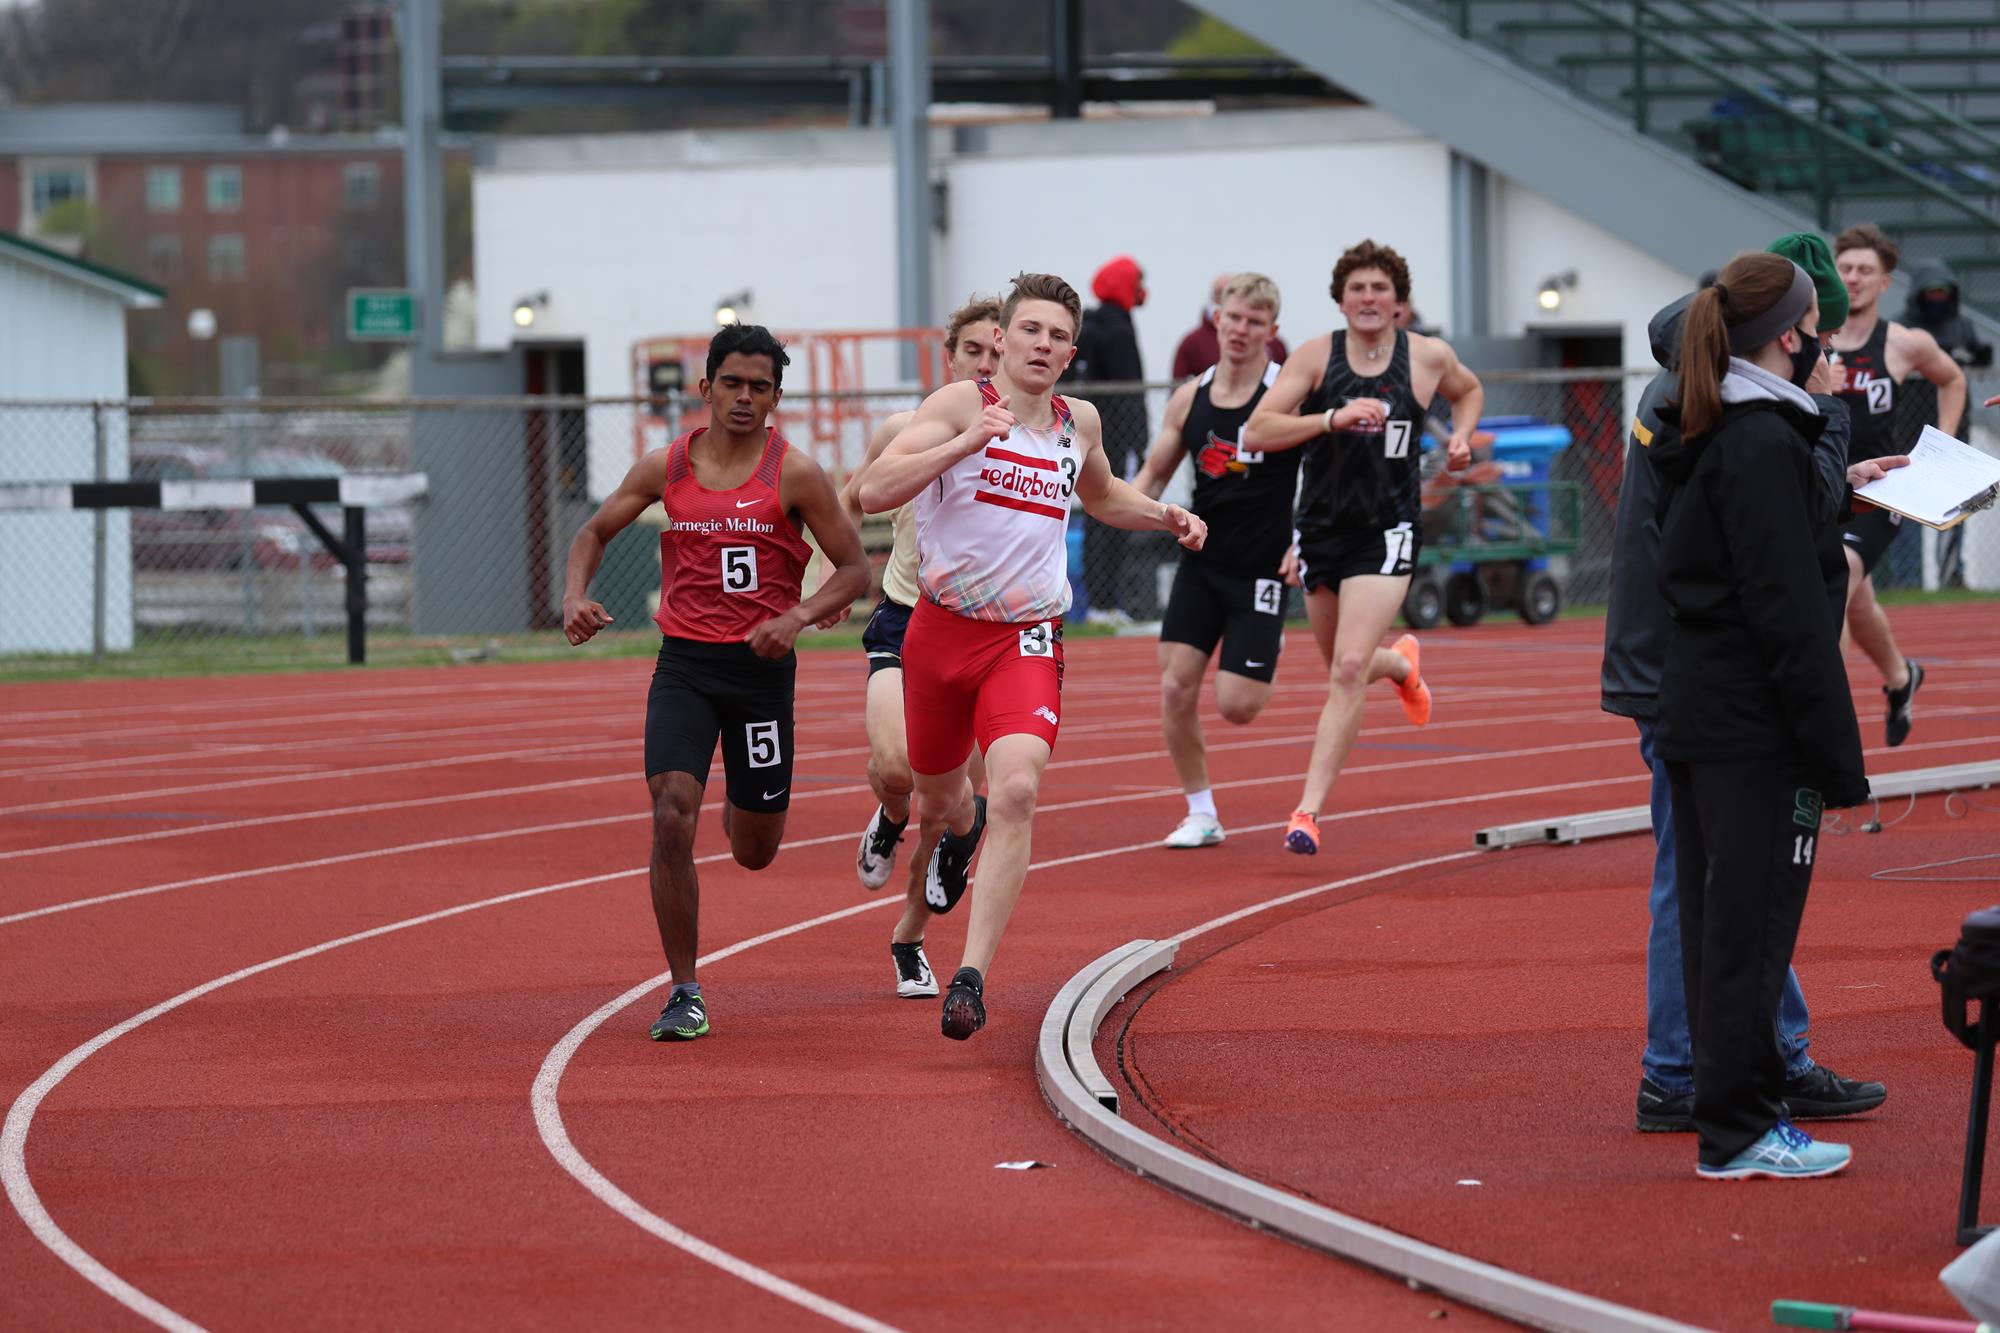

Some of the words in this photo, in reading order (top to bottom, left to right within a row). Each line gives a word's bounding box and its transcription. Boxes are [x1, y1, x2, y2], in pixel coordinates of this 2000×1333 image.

[1871, 384, 1887, 409] 2
[1393, 424, 1407, 456] 7
[1061, 457, 1076, 498] 3
[671, 518, 723, 535] arnegie
[725, 517, 774, 533] Mellon
[1392, 530, 1406, 560] 7
[727, 550, 752, 590] 5
[1260, 583, 1277, 610] 4
[1024, 624, 1048, 655] 3
[751, 725, 776, 765] 5
[1793, 787, 1821, 829] S
[1793, 835, 1814, 865] 14
